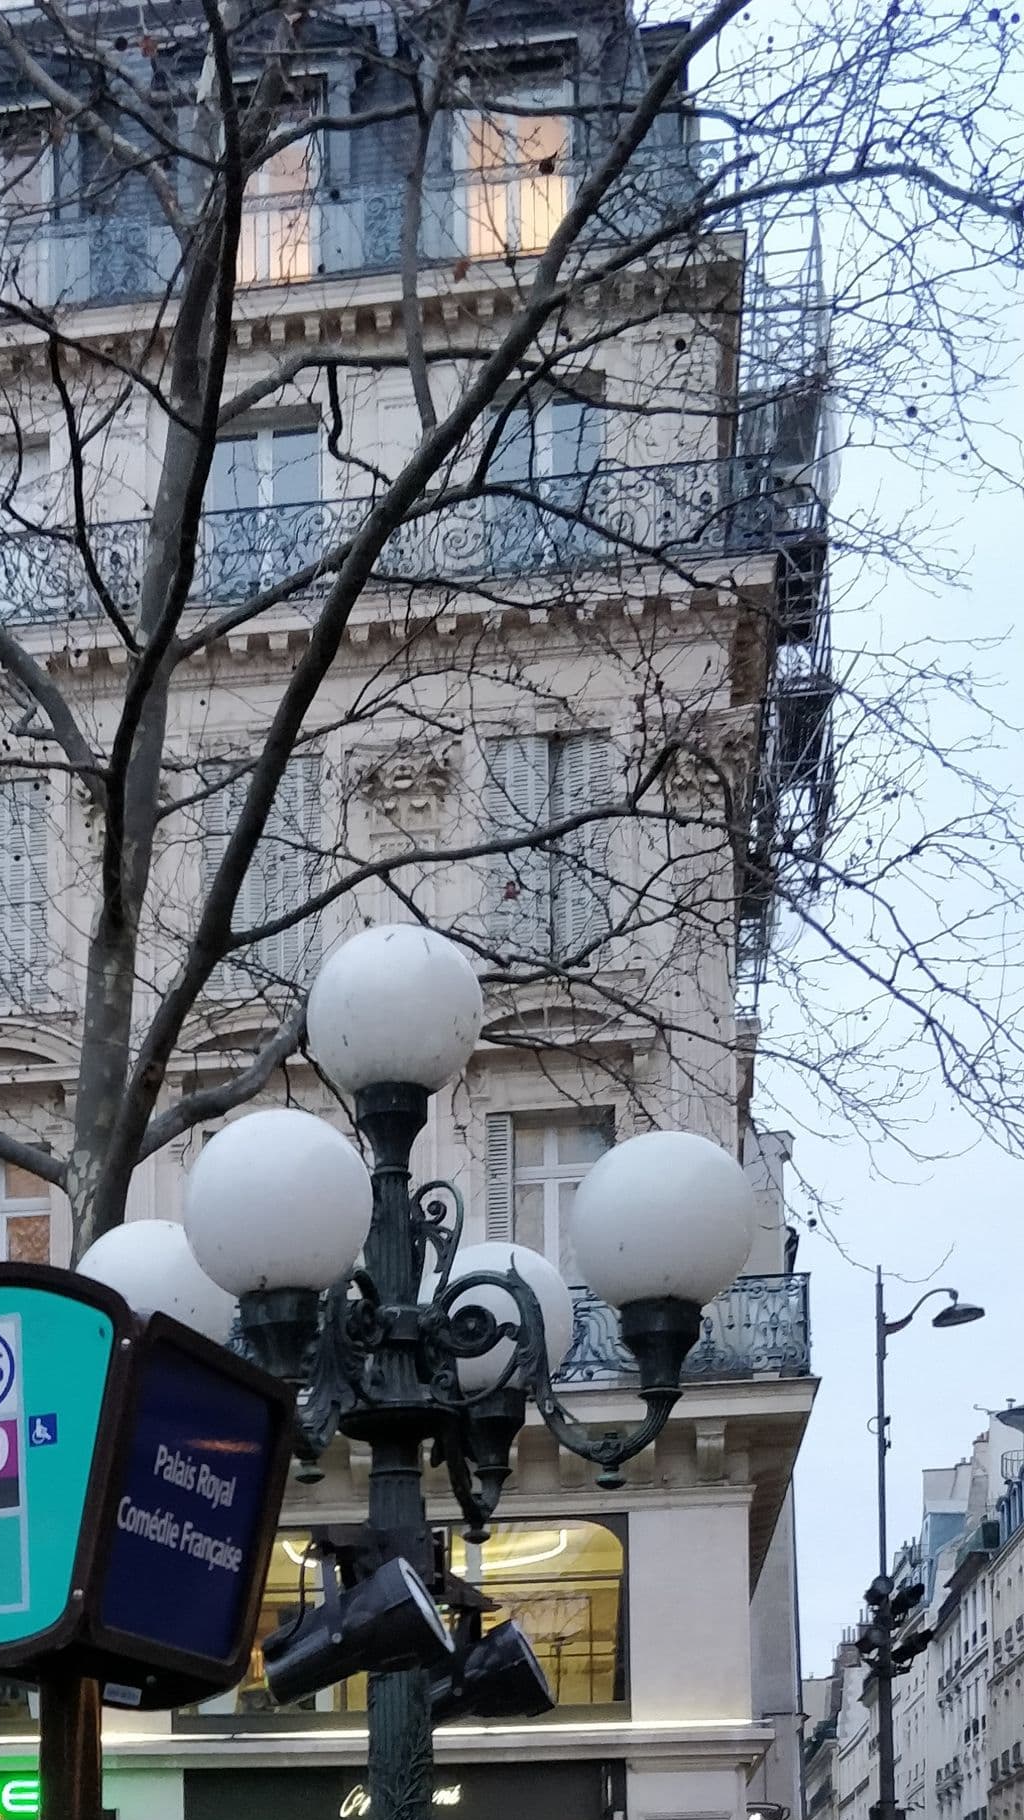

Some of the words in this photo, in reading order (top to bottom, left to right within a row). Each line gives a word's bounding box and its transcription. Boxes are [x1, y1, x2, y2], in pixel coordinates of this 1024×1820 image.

[153, 1444, 197, 1491] Palais
[196, 1463, 236, 1509] Royal
[117, 1496, 180, 1549] Comédie
[180, 1520, 243, 1572] Française
